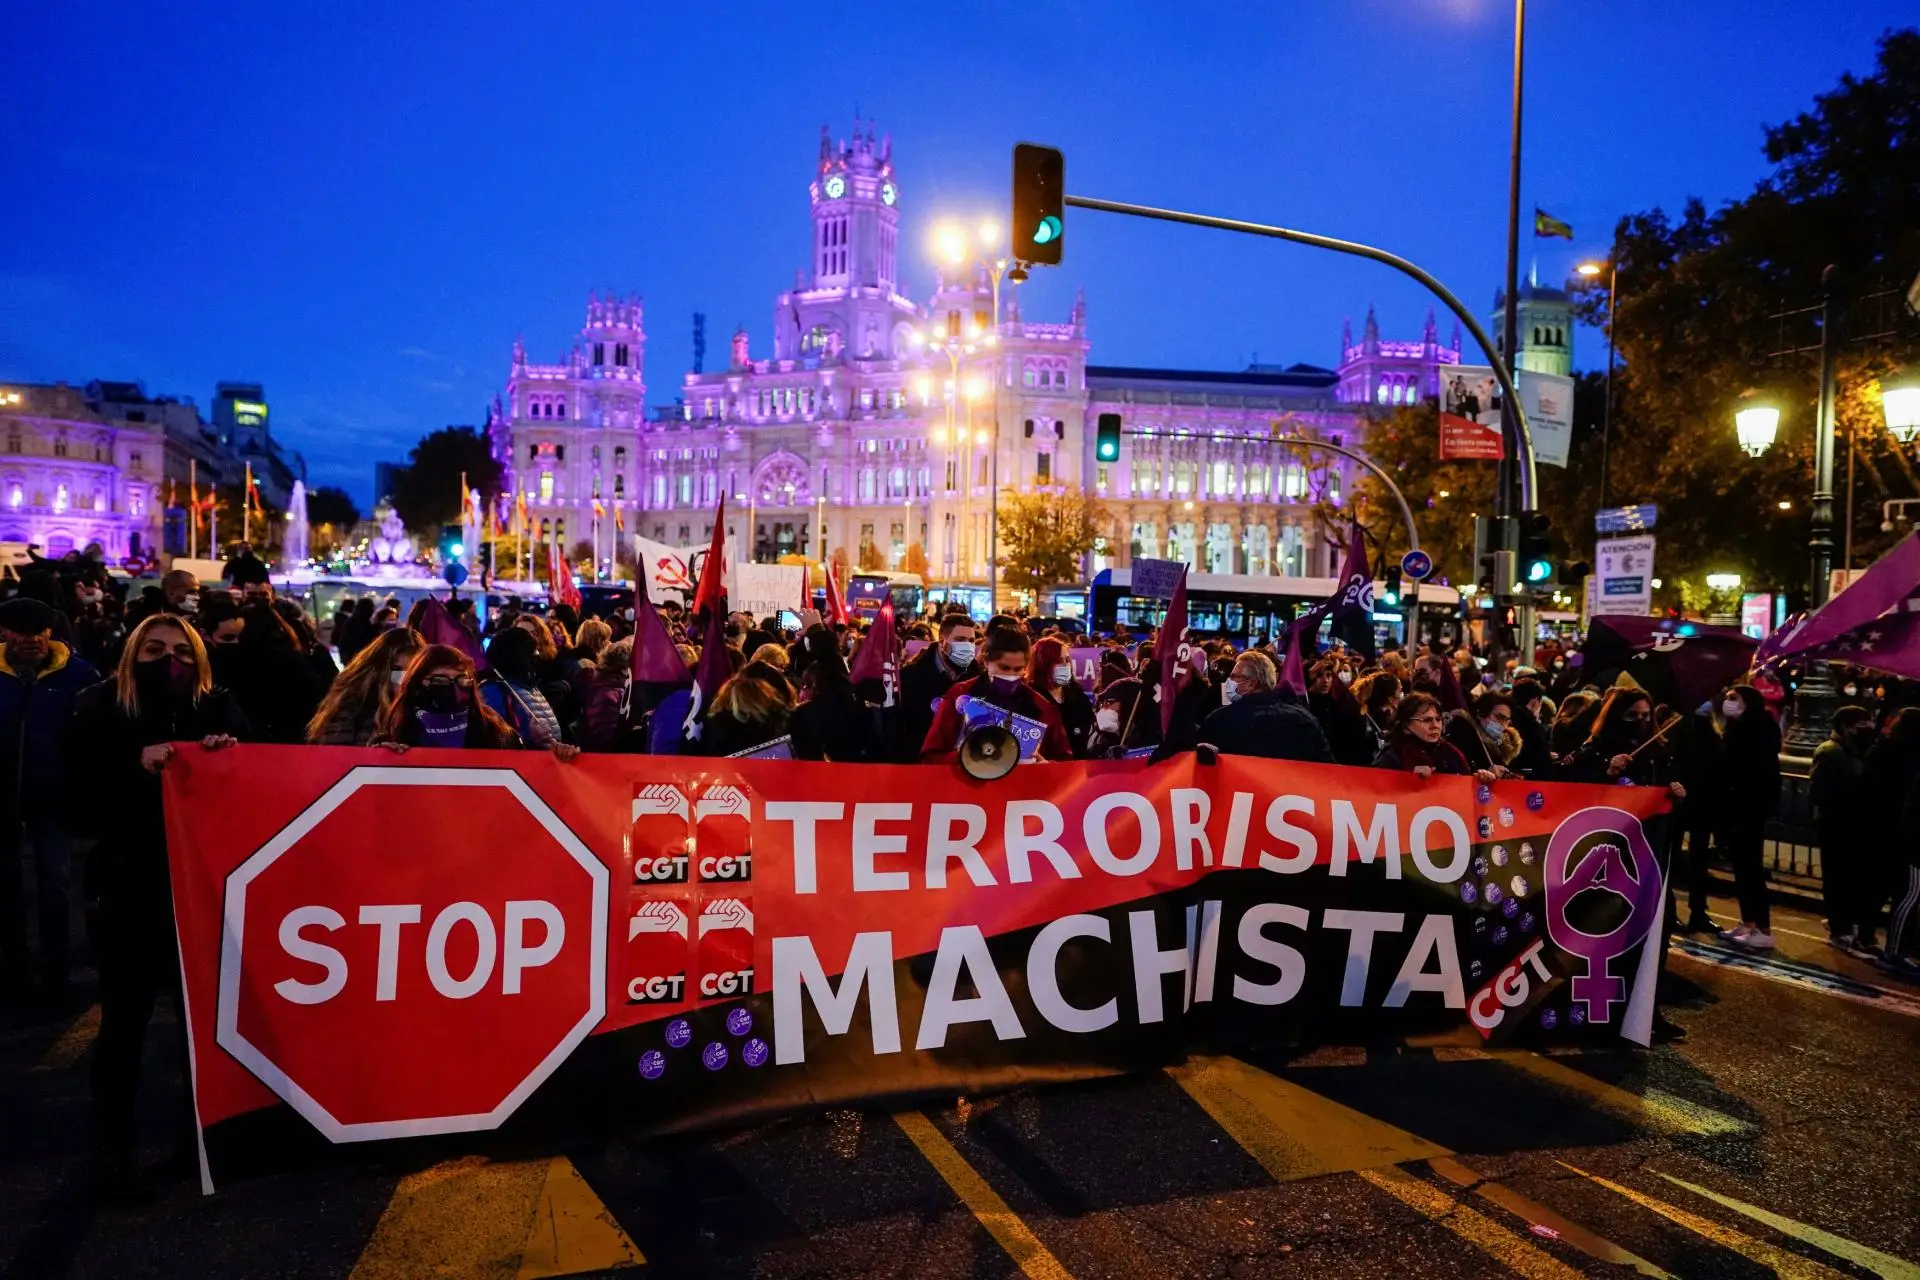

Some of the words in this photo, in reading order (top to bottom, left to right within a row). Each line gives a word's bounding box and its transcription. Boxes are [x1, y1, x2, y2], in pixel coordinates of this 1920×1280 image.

[1600, 543, 1651, 554] ATENCIÓN
[765, 788, 1471, 894] TERRORISMO
[634, 856, 688, 880] CGT
[699, 856, 751, 879] CGT
[274, 900, 565, 1005] STOP
[627, 975, 685, 1000] CGT
[700, 969, 754, 996] CGT
[772, 900, 1466, 1066] MACHISTA
[1470, 939, 1552, 1029] CGT
